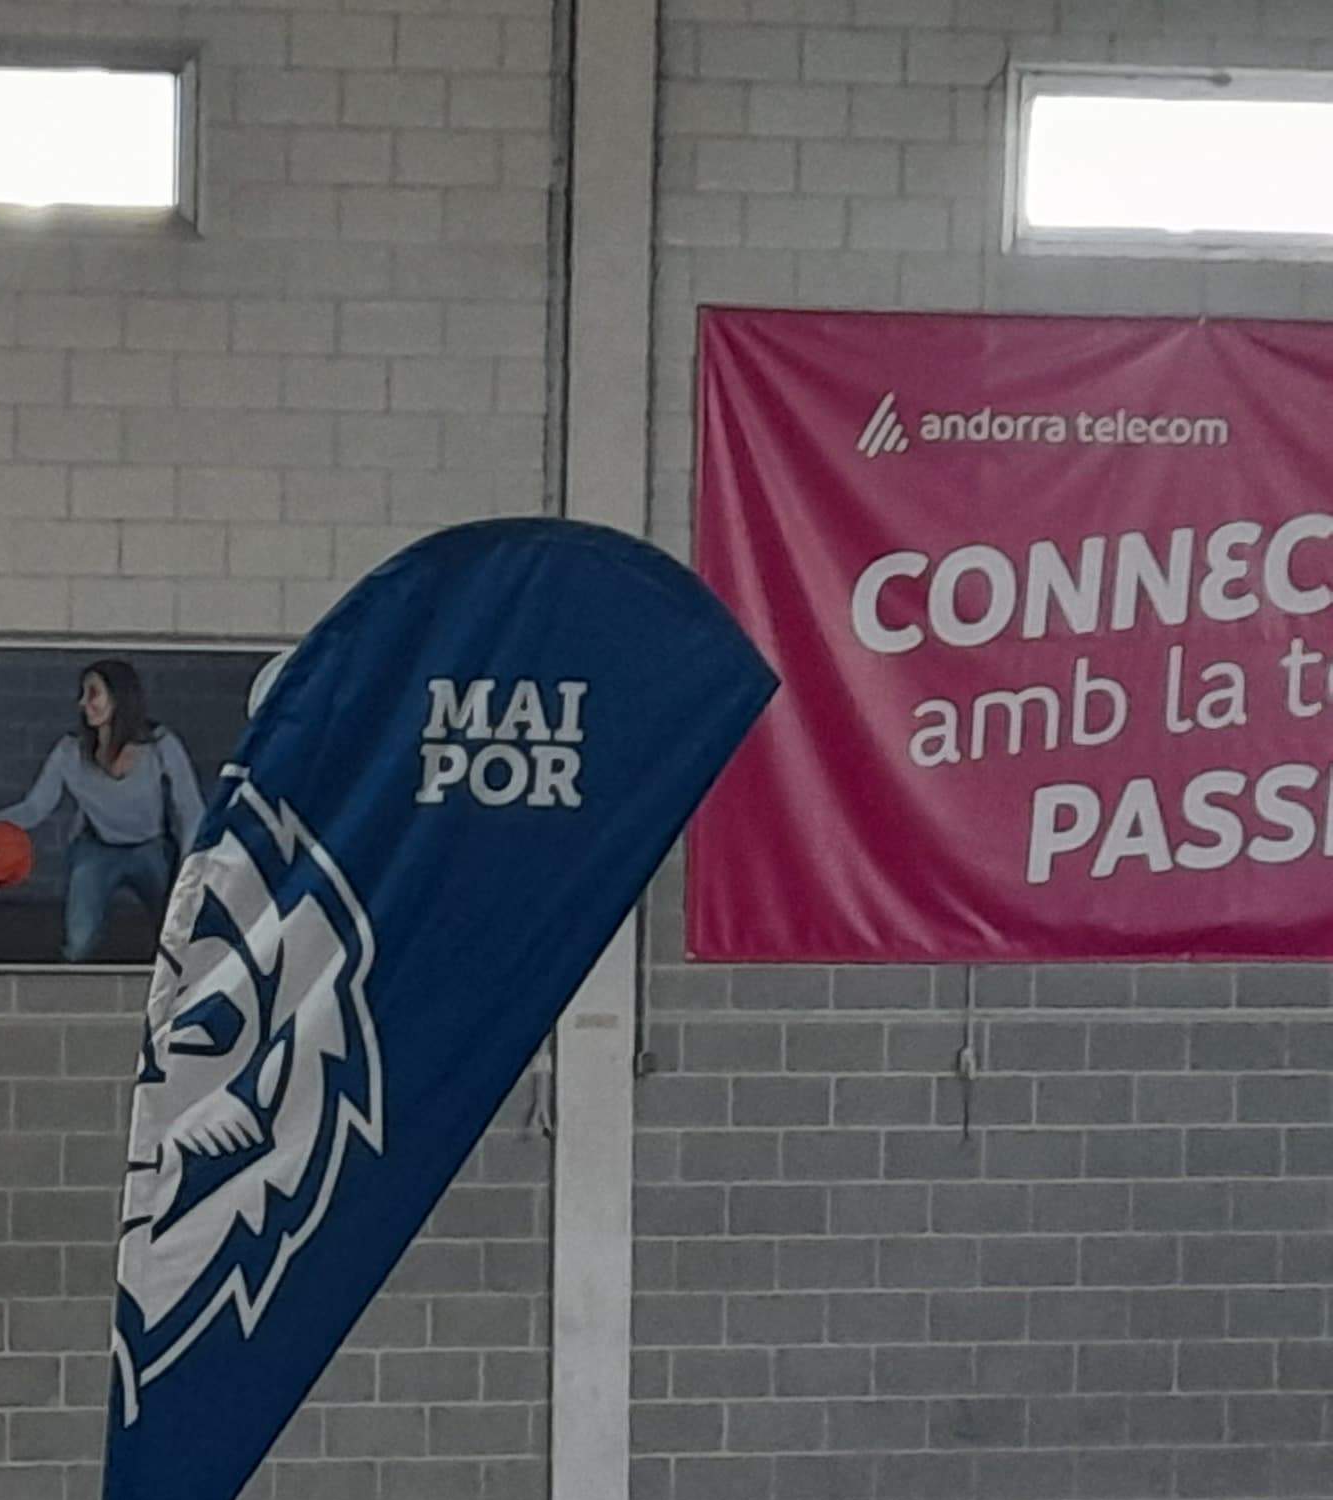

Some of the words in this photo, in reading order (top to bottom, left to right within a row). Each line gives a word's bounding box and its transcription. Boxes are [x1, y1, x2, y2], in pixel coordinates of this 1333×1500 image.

[920, 406, 1067, 443] andorra
[1076, 408, 1228, 445] telecom
[421, 677, 589, 743] MAI
[908, 657, 1129, 767] amb
[1166, 645, 1247, 734] la
[1279, 637, 1333, 718] t
[414, 742, 583, 808] POR
